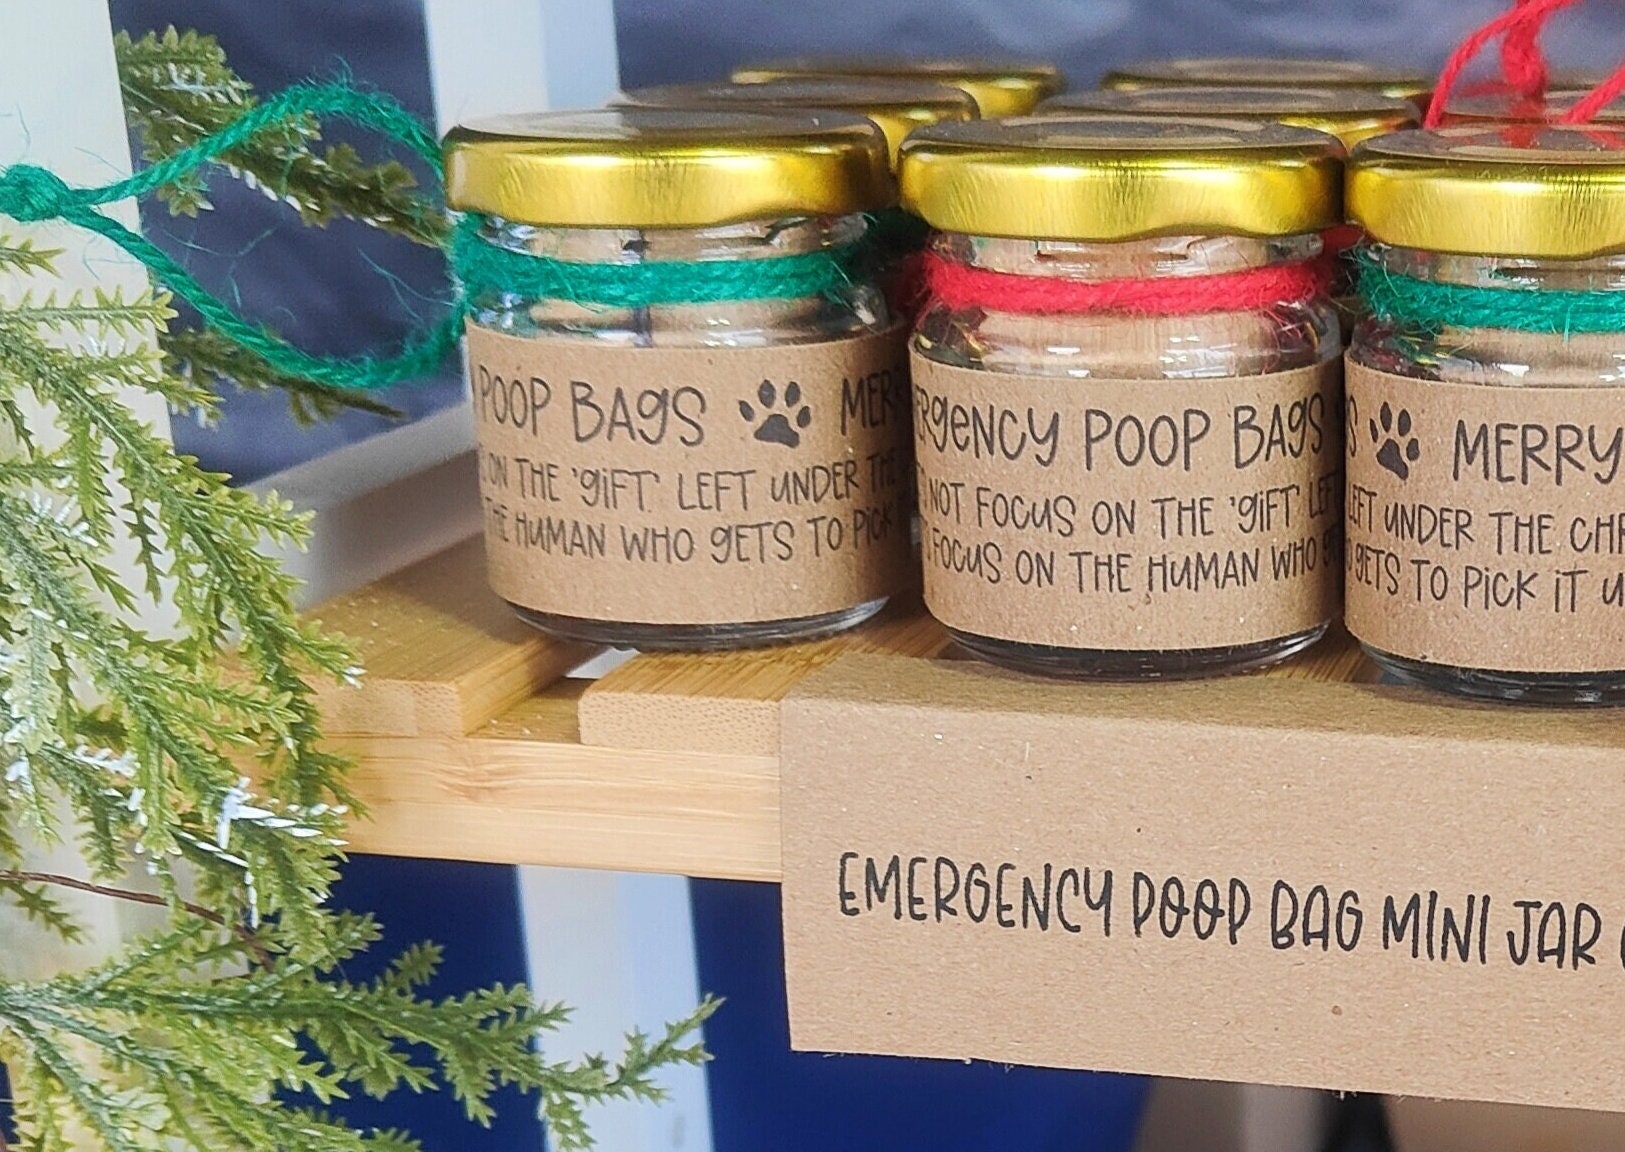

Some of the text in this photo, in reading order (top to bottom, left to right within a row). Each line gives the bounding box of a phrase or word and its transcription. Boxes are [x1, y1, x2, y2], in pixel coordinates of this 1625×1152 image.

[479, 364, 551, 436] POOP
[1085, 408, 1211, 471] POOP
[1453, 419, 1624, 487] MERRY
[489, 452, 508, 489] ON
[514, 458, 561, 503] THE
[677, 469, 757, 511] LEFT
[929, 478, 966, 525] NOT
[1092, 500, 1135, 536] ON
[1151, 496, 1215, 540] THE
[619, 522, 695, 563] WHO
[808, 516, 843, 558] TO
[1488, 511, 1554, 556] THE
[1015, 549, 1054, 587] ON
[1068, 550, 1132, 593] THE
[1271, 536, 1318, 581] WHO
[1409, 558, 1449, 602] TO
[838, 851, 1113, 938] EMERGENCY
[1132, 871, 1252, 946] POOP
[1270, 879, 1363, 952] BAG
[1383, 890, 1491, 966] MINI
[1506, 900, 1603, 971] JAR
